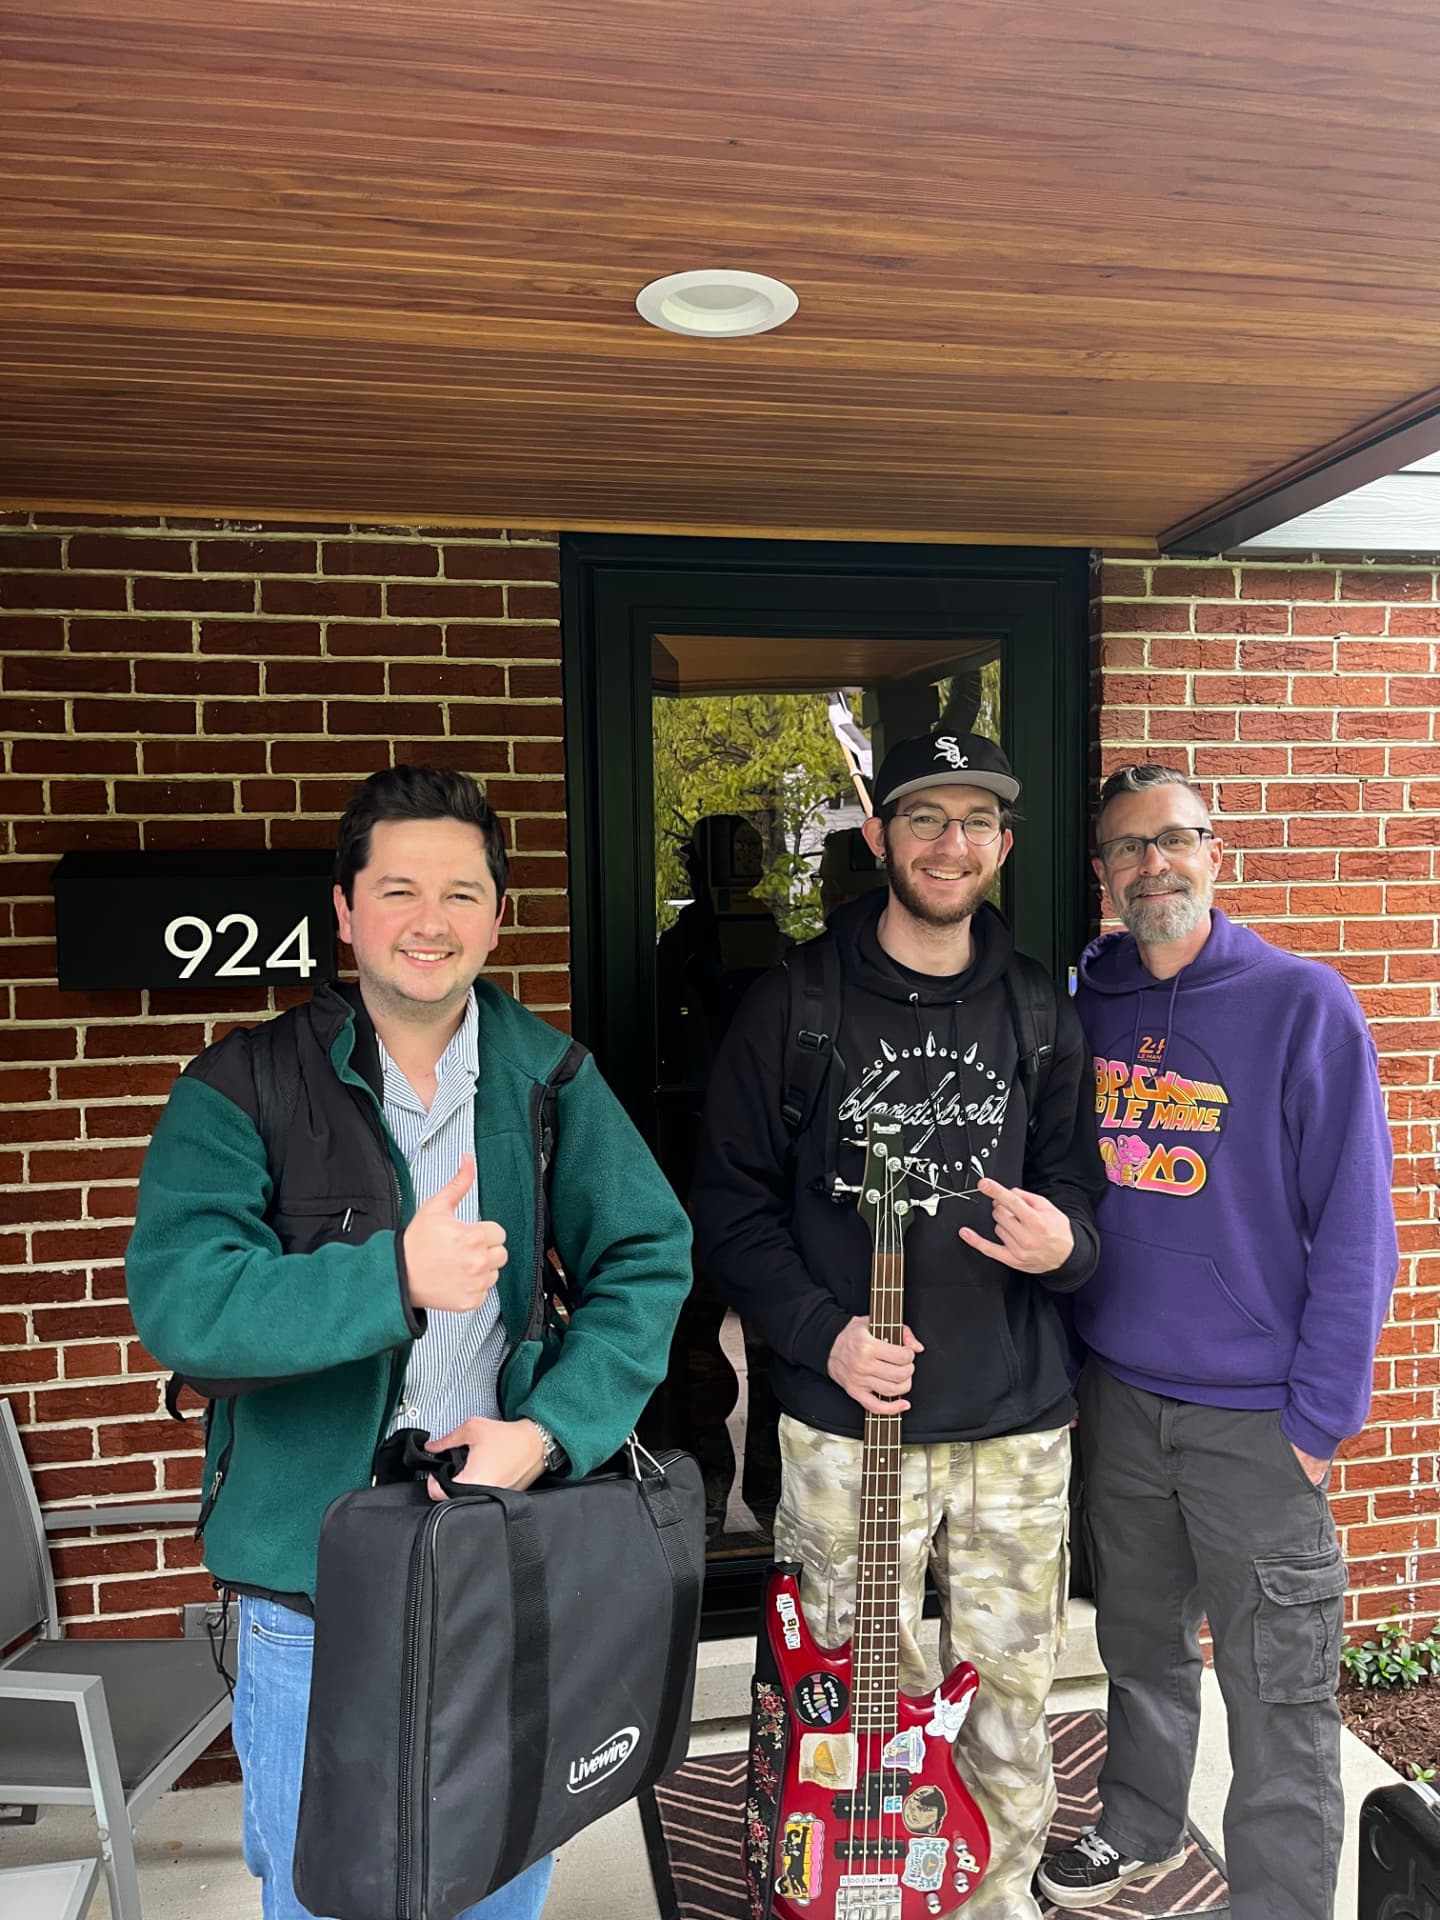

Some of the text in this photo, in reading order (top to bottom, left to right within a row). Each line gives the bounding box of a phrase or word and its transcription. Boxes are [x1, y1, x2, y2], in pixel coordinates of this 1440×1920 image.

[933, 736, 968, 768] Sox
[164, 913, 317, 979] 924
[1101, 1097, 1148, 1128] LE
[569, 1740, 629, 1785] Livewire
